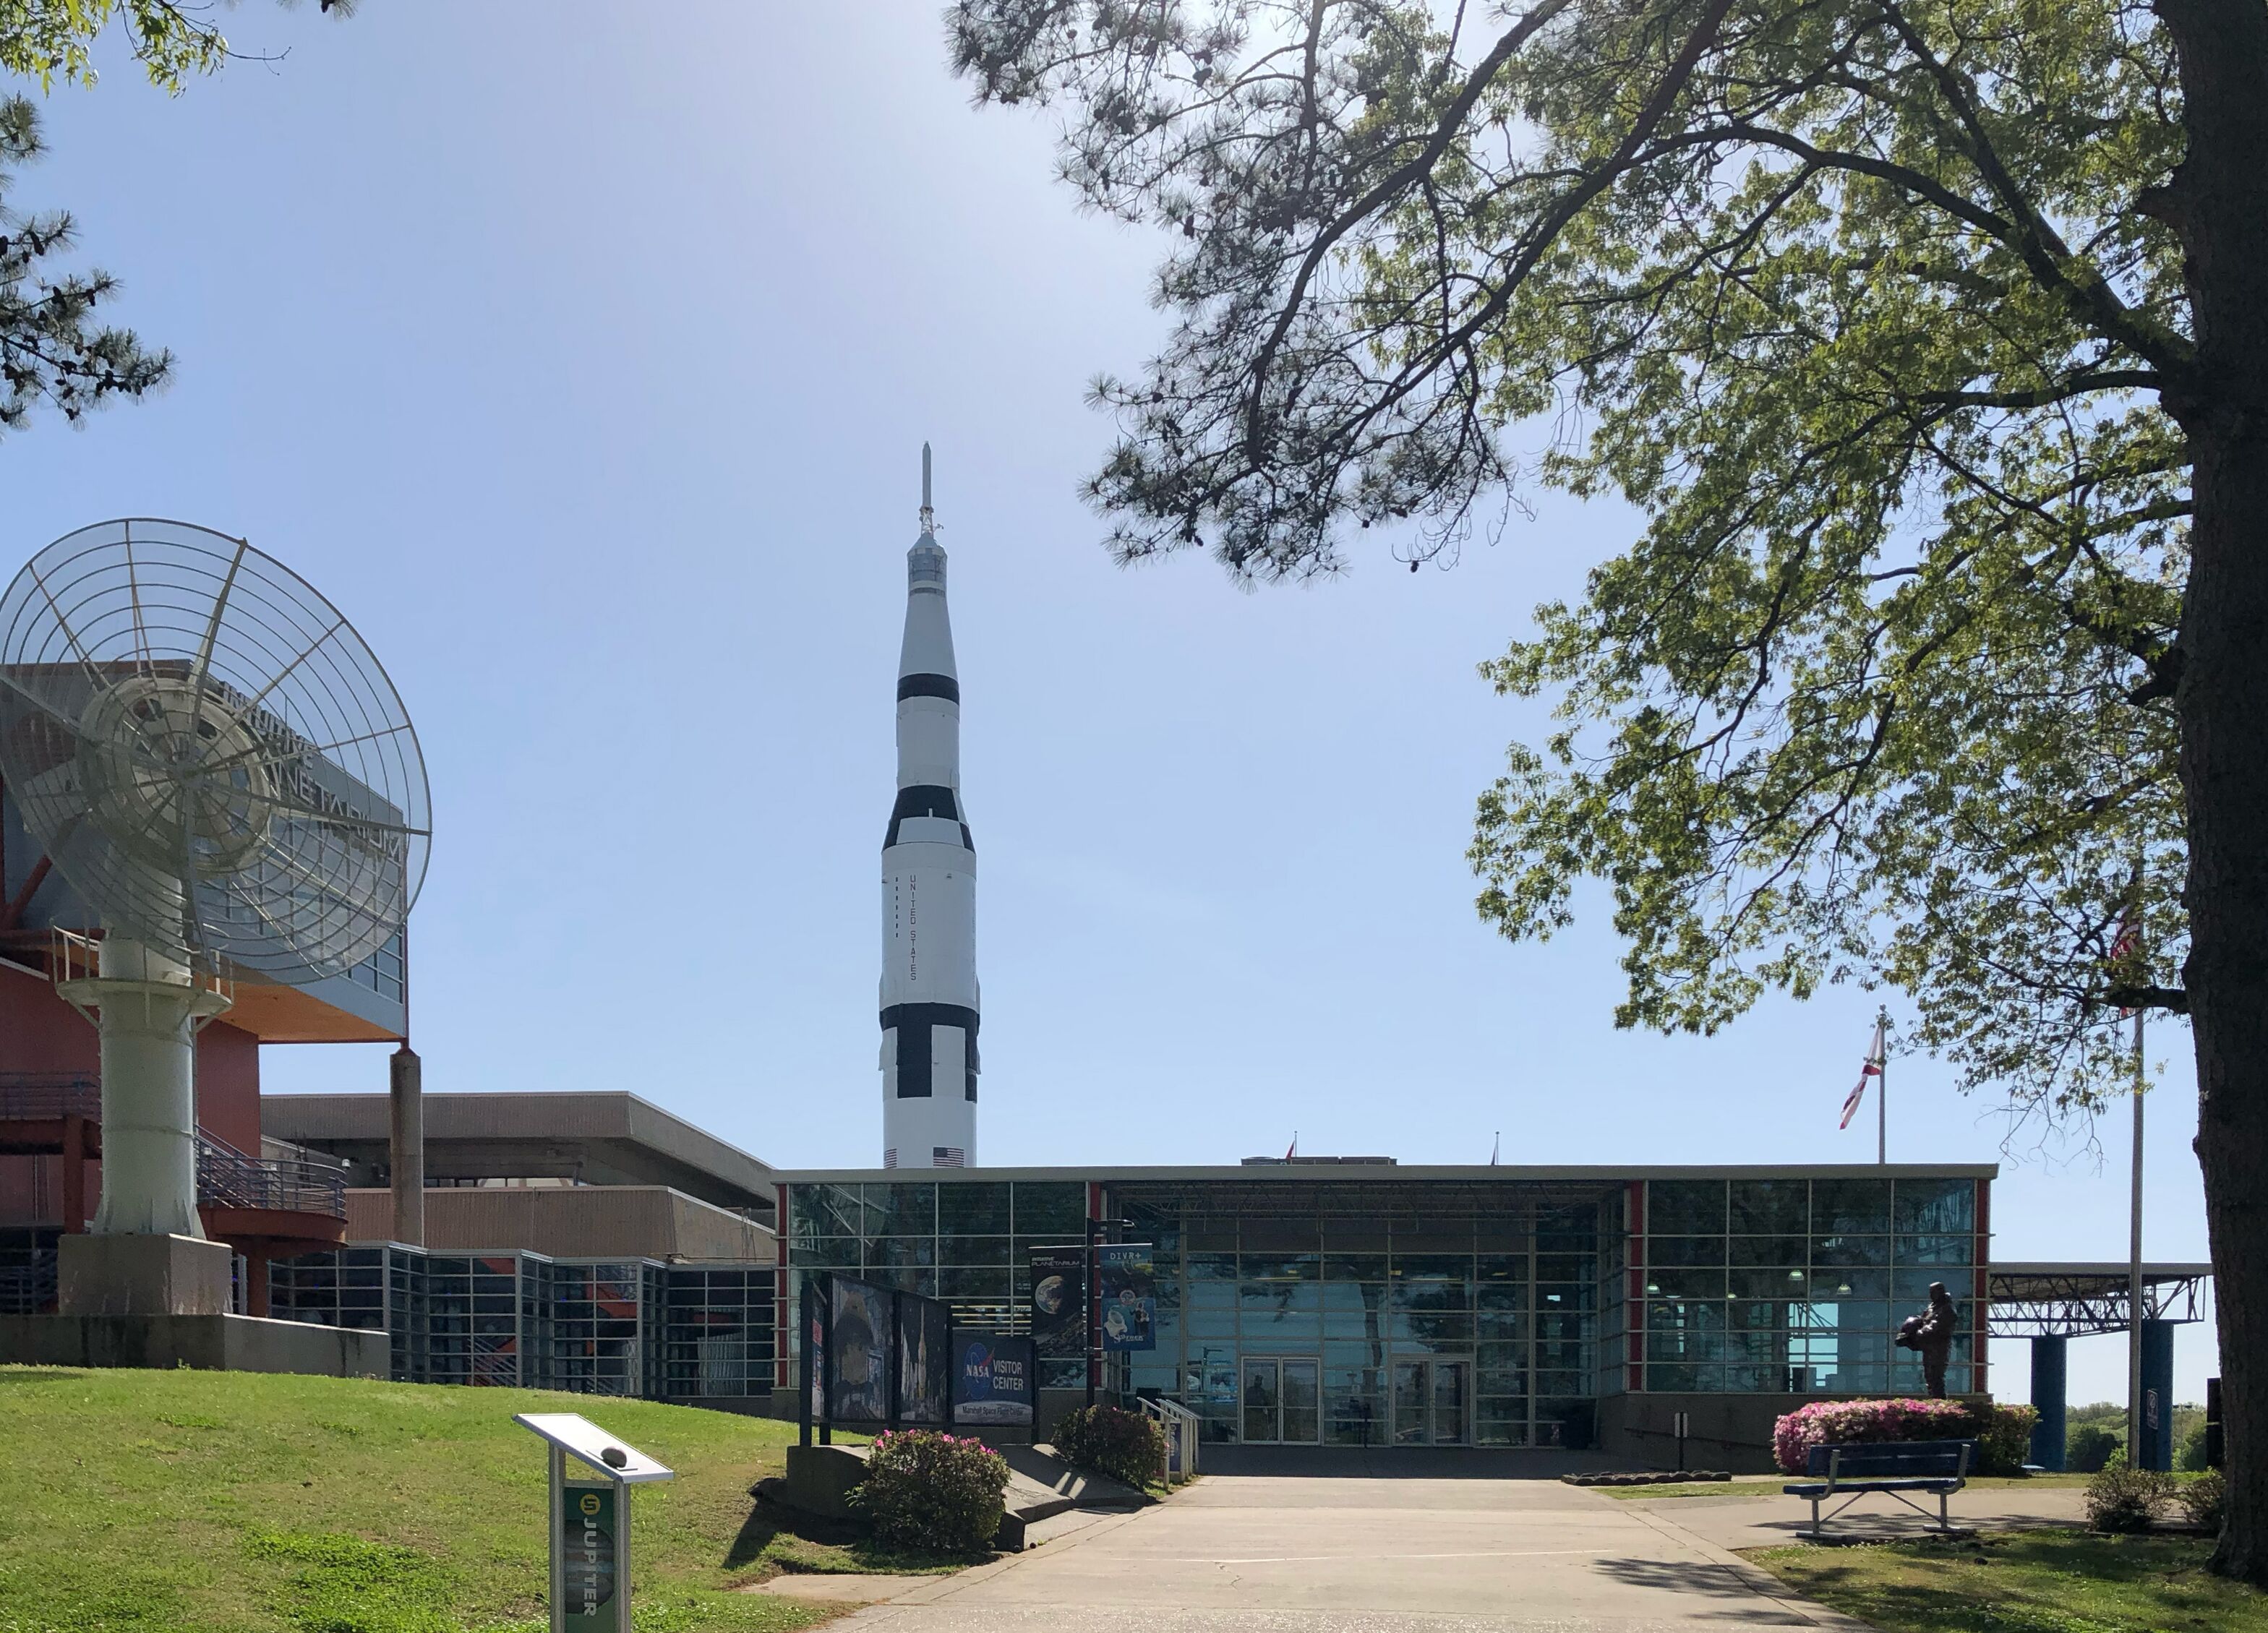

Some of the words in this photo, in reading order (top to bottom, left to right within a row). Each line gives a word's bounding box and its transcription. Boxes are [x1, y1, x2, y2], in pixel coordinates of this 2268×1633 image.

[966, 1364, 989, 1378] NASA
[993, 1360, 1022, 1375] VISITOR
[993, 1376, 1024, 1391] CENTER
[584, 1518, 597, 1616] JUPITER
